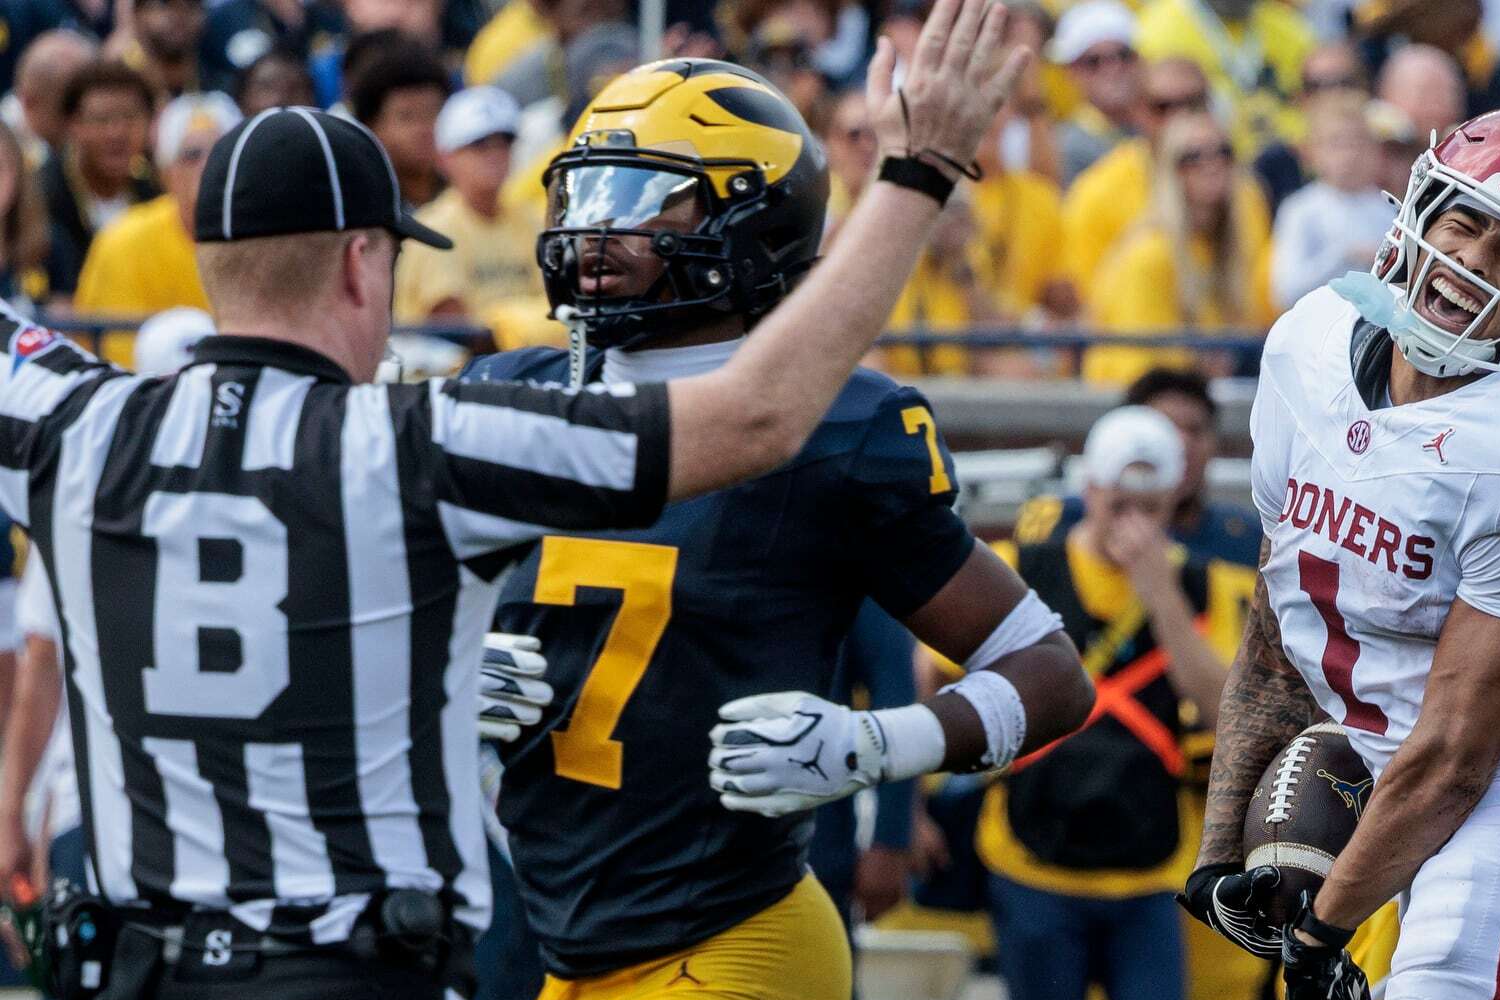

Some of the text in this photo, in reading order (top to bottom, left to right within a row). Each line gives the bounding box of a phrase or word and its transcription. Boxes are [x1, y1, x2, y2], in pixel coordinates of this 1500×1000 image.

[900, 405, 952, 495] 7
[141, 491, 291, 720] B
[533, 535, 679, 790] 7
[1298, 549, 1390, 736] 1
